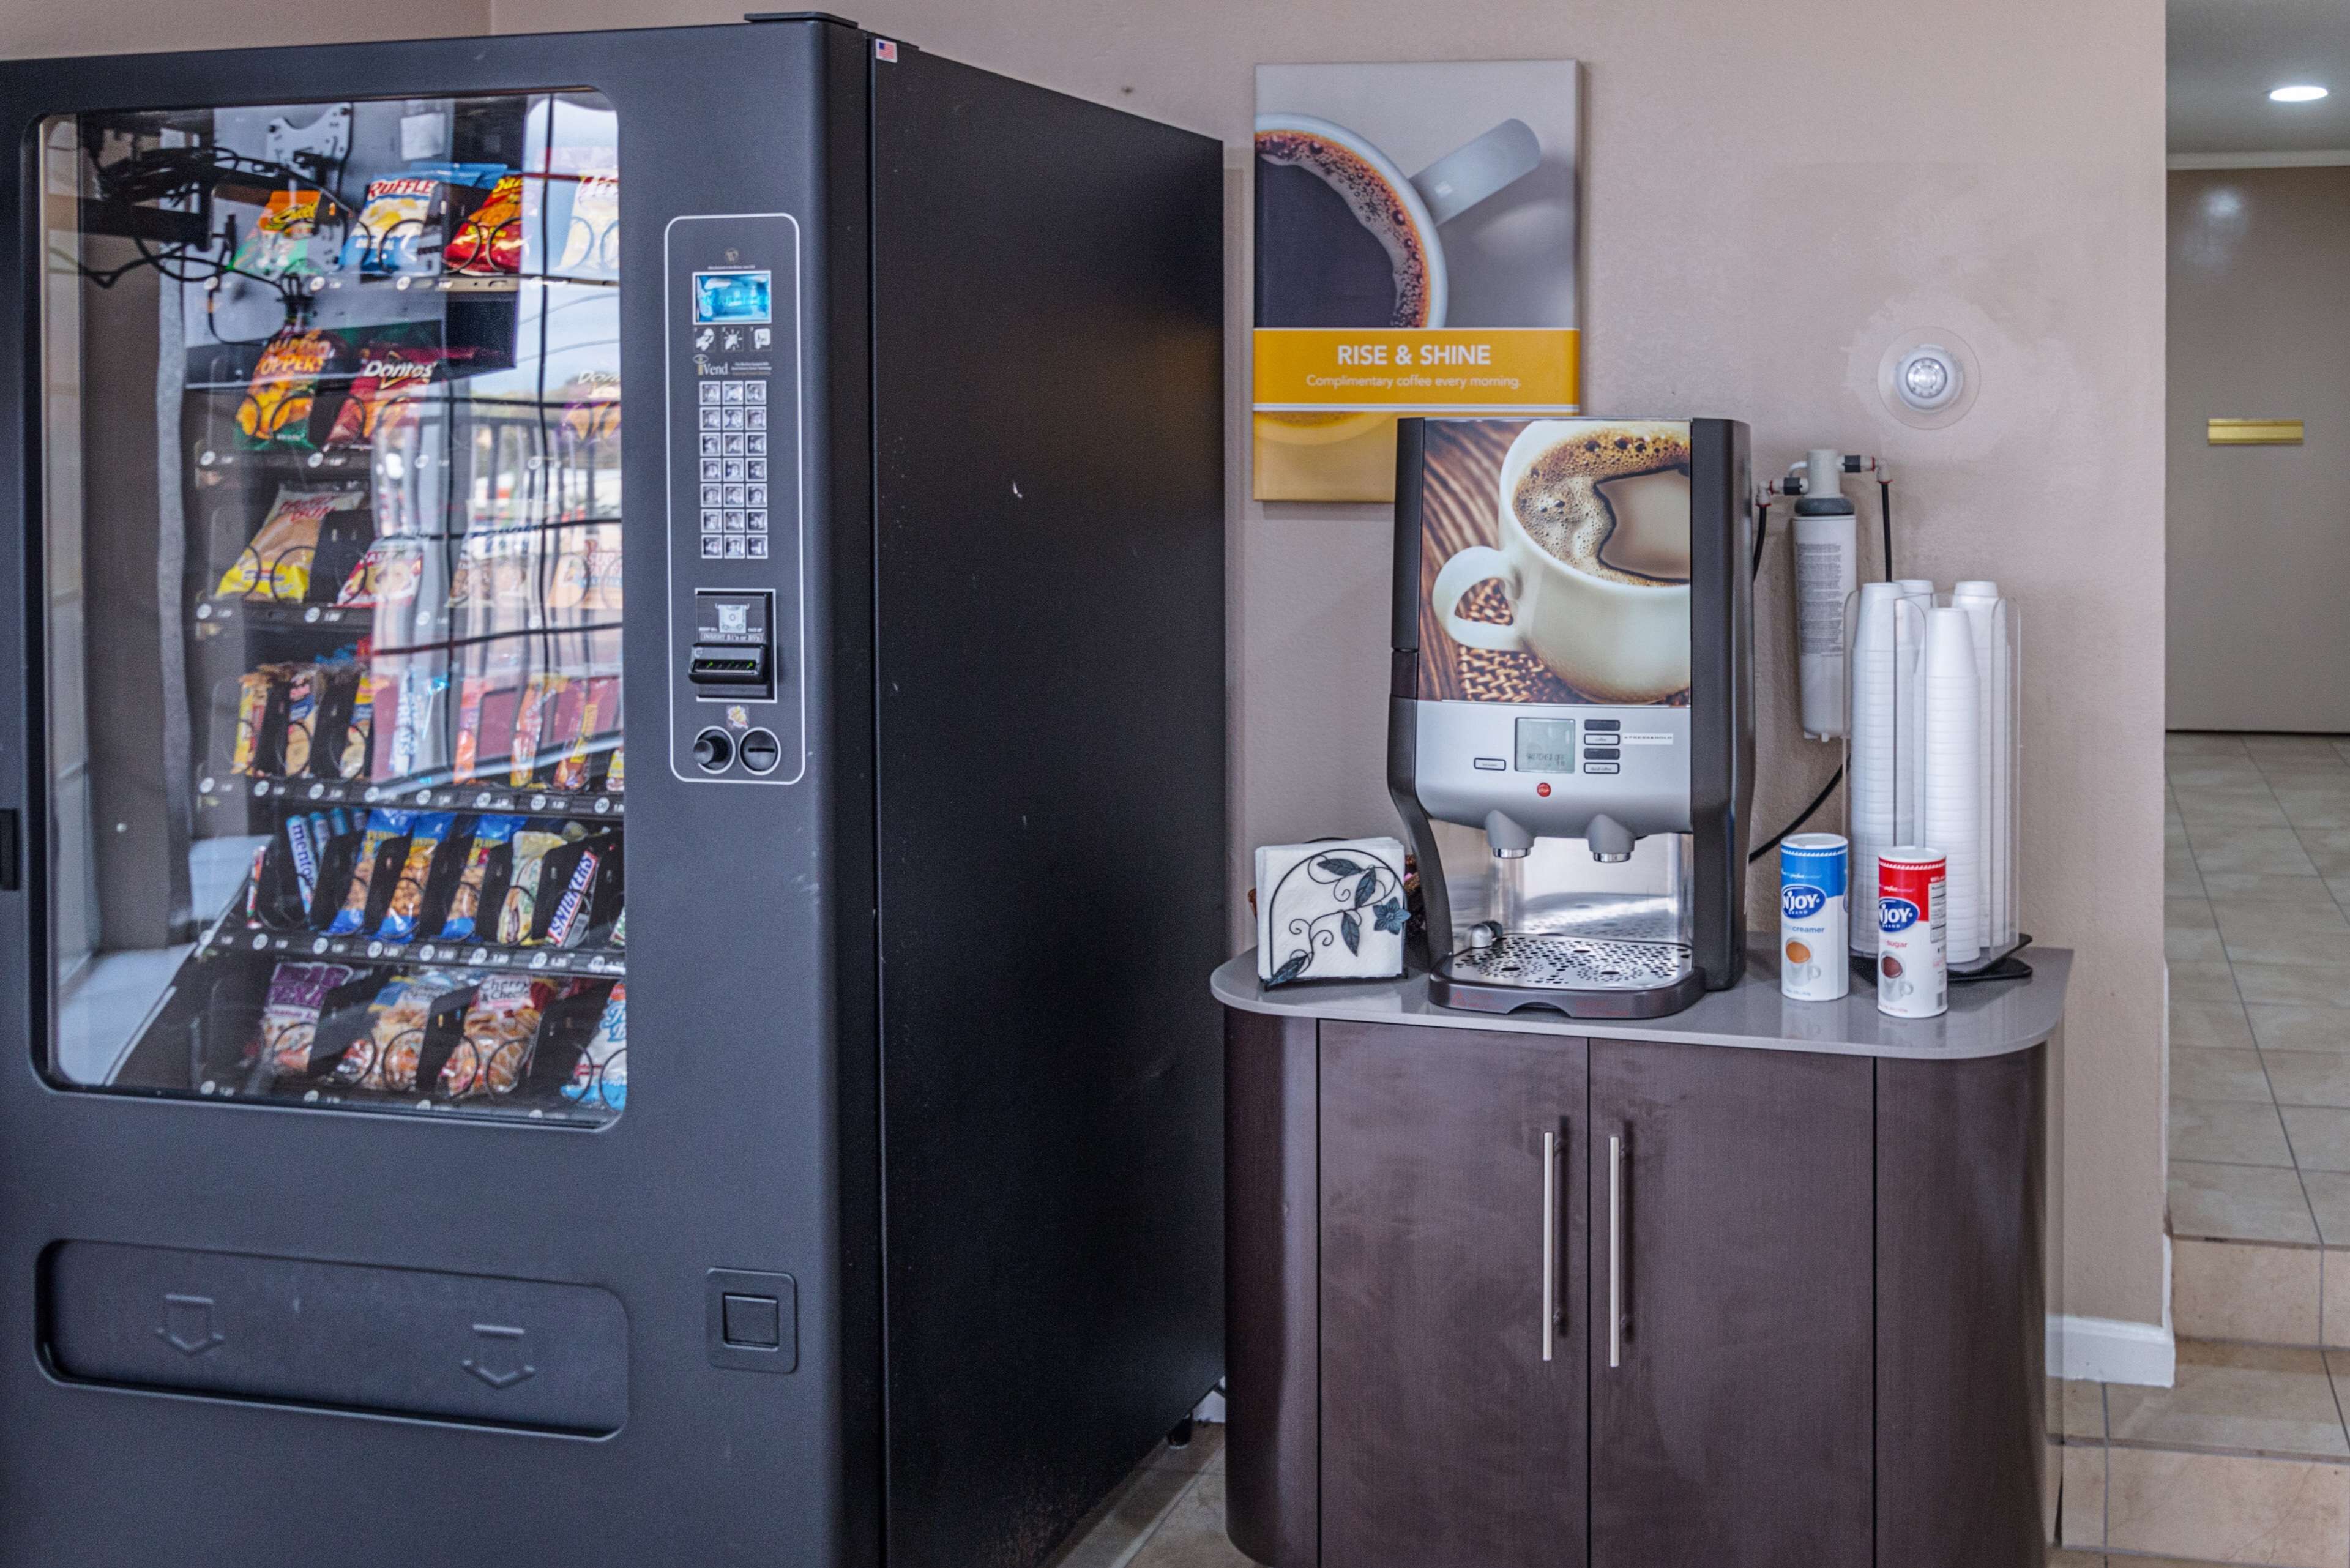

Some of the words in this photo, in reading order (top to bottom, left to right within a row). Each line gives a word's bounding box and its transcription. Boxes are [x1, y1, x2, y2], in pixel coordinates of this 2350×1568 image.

[368, 179, 437, 198] RUFFLE
[1337, 345, 1387, 365] RISE
[1395, 345, 1412, 365] &
[1420, 345, 1491, 365] SHINE
[363, 360, 433, 378] Doritos
[1306, 374, 1394, 390] Complimentary
[1396, 375, 1431, 387] coffee
[1435, 378, 1467, 390] every
[1470, 375, 1521, 390] morning.
[551, 856, 592, 938] SNICKERS
[1791, 925, 1826, 934] creamer
[1886, 939, 1908, 948] sugar
